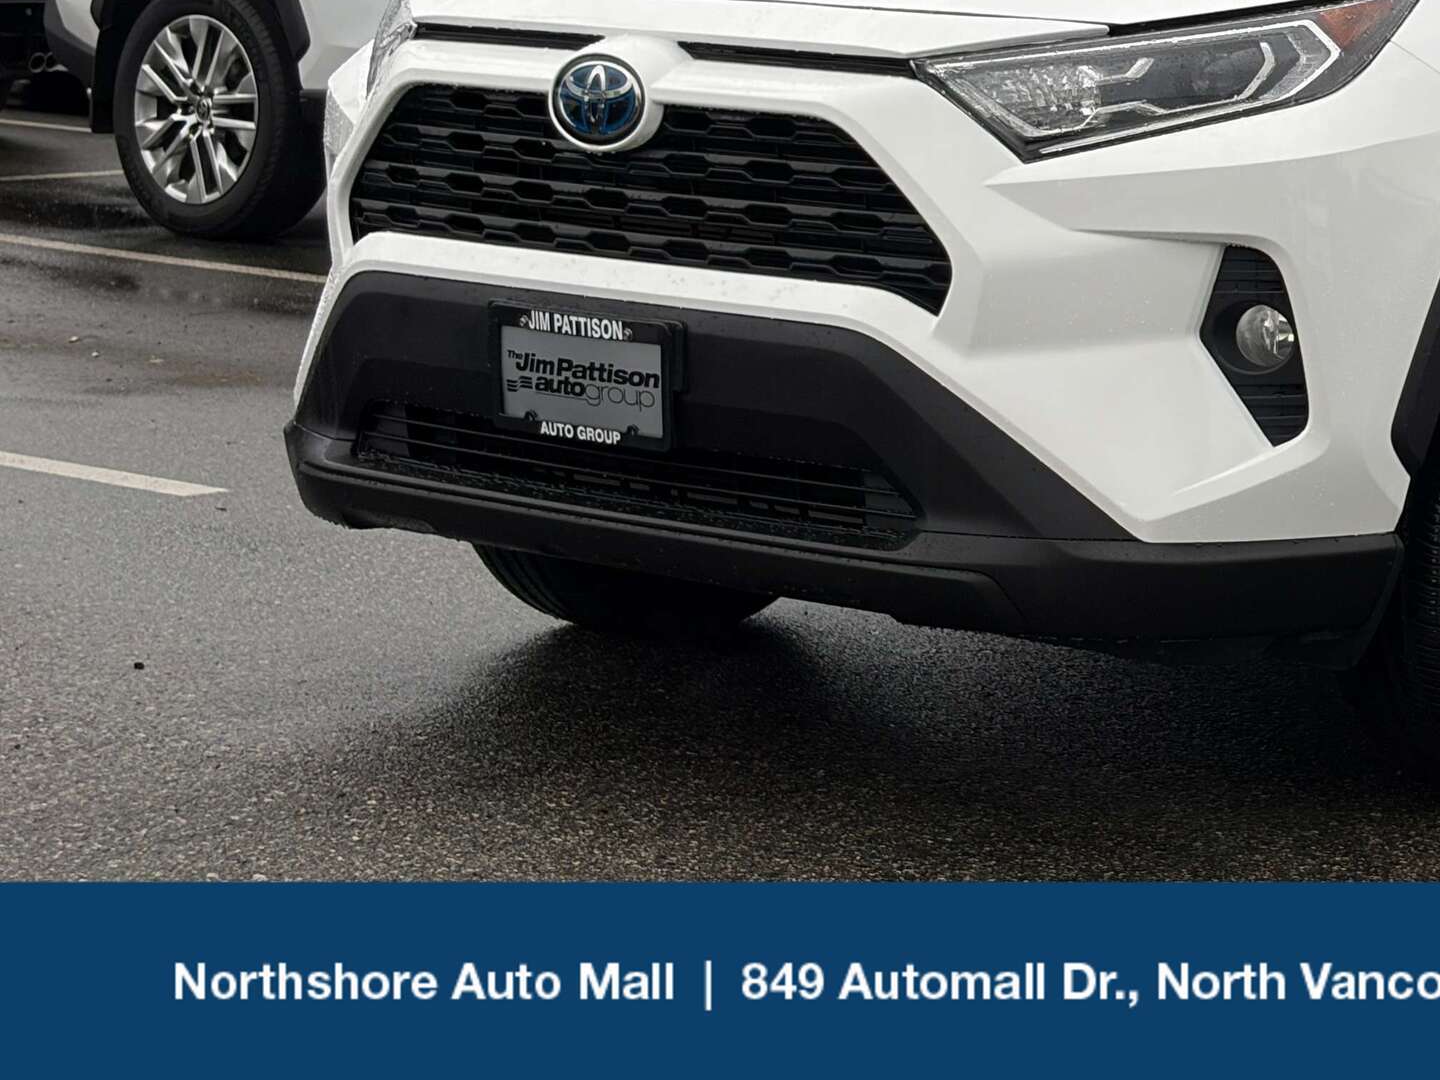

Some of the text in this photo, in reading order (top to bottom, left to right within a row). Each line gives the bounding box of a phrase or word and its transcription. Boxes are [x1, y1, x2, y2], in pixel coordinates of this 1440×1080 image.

[528, 310, 623, 340] JIM PATTISON
[507, 349, 523, 360] The
[540, 421, 621, 445] AUTO GROUP
